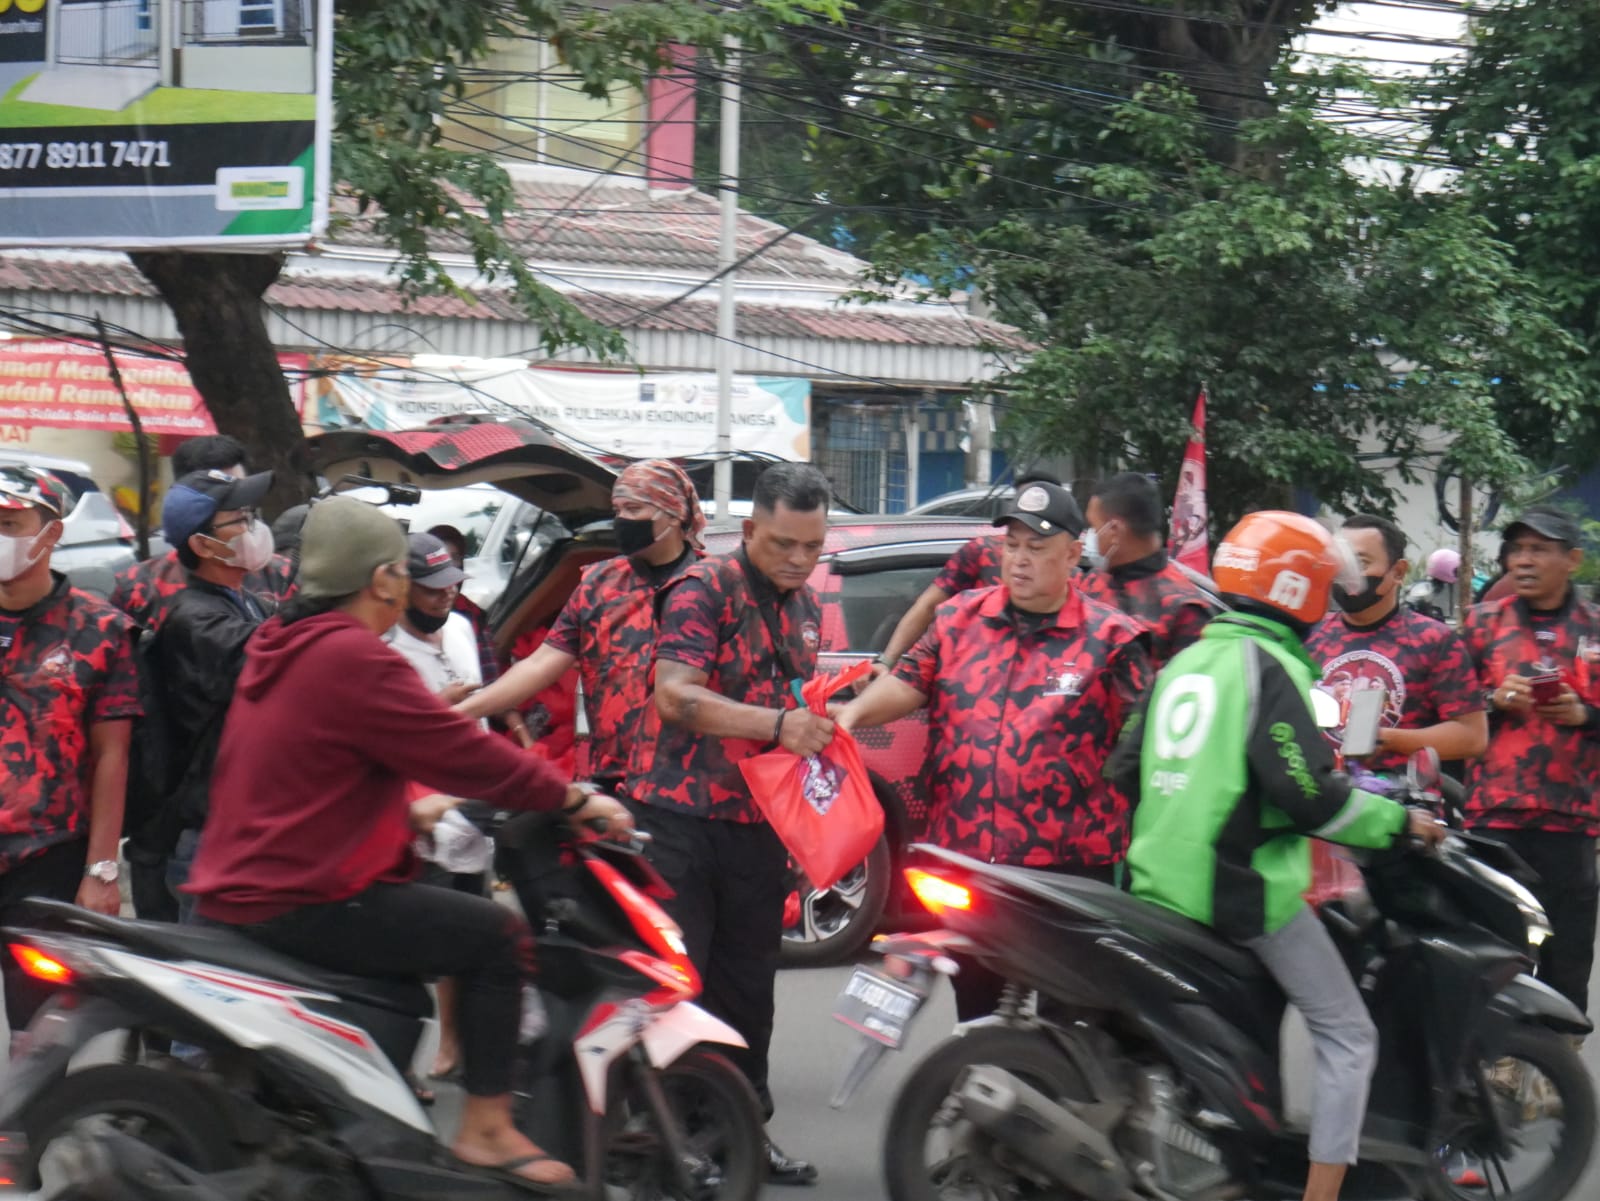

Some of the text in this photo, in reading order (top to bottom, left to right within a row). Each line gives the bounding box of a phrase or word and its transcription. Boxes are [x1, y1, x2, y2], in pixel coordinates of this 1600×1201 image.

[45, 142, 106, 169] 8911
[110, 140, 171, 168] 7471
[729, 412, 777, 427] ANGSA
